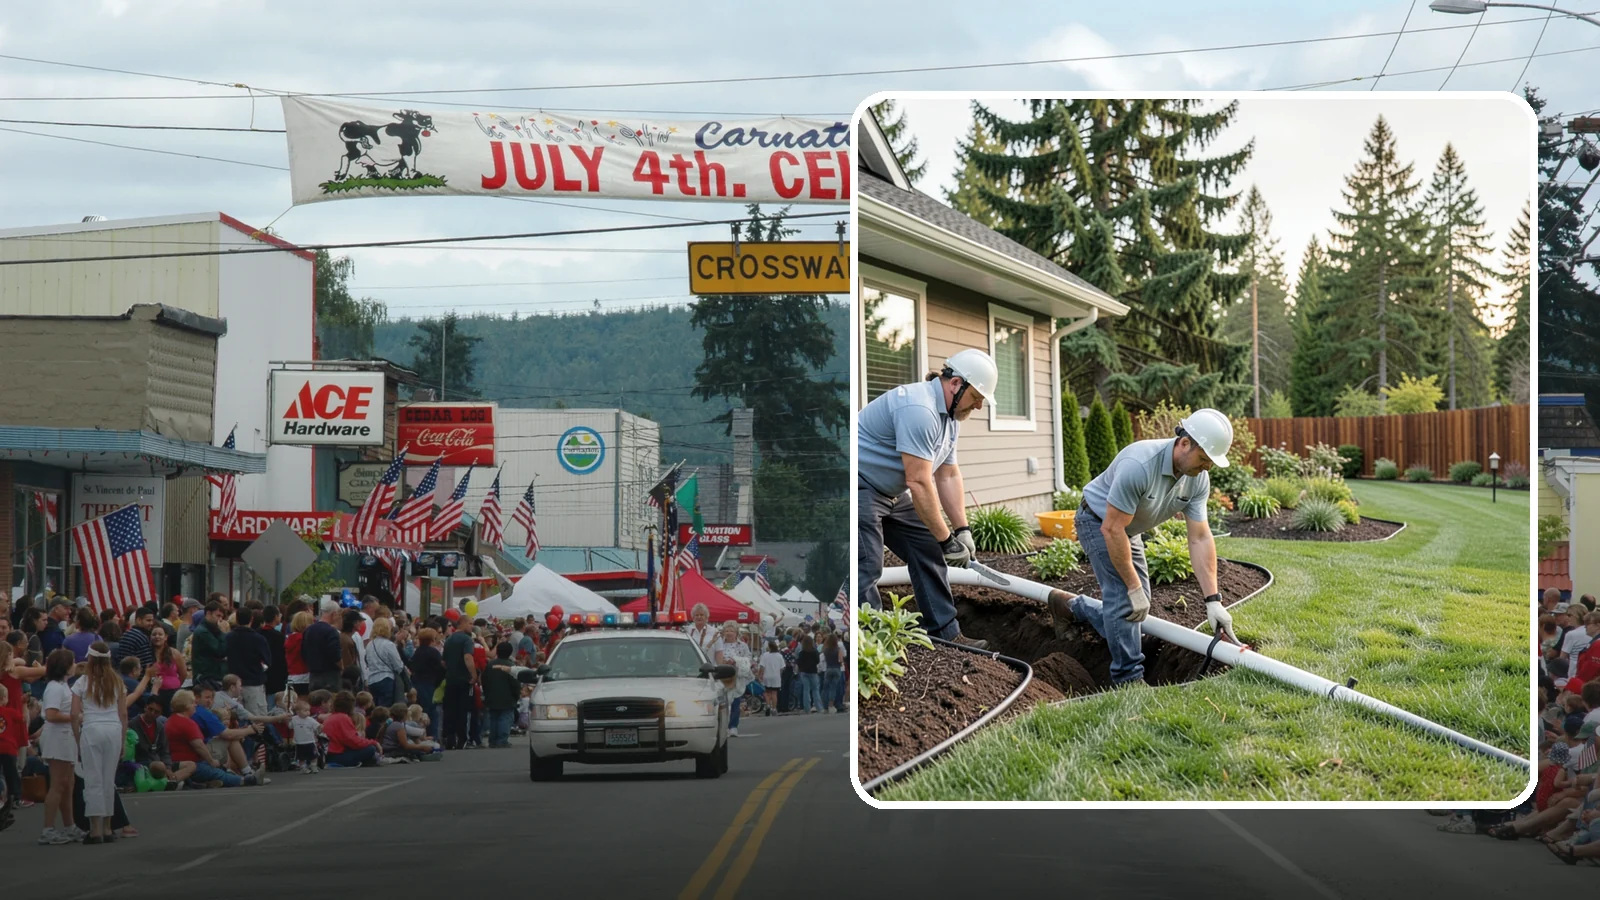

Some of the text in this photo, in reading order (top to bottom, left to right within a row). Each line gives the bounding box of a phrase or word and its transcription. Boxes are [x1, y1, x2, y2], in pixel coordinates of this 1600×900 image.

[481, 141, 604, 193] JULY
[632, 150, 747, 198] 4th.
[697, 253, 850, 281] CROSSWA
[282, 380, 374, 421] ACE
[406, 408, 485, 422] CEDAR LOG
[283, 421, 371, 437] Hardware
[416, 428, 477, 447] Coca-Cola
[353, 467, 386, 480] Simpl
[83, 485, 155, 496] St. Vincent de Paul
[80, 503, 154, 522] THT
[688, 526, 741, 536] CRNATION
[699, 535, 731, 544] GLASS
